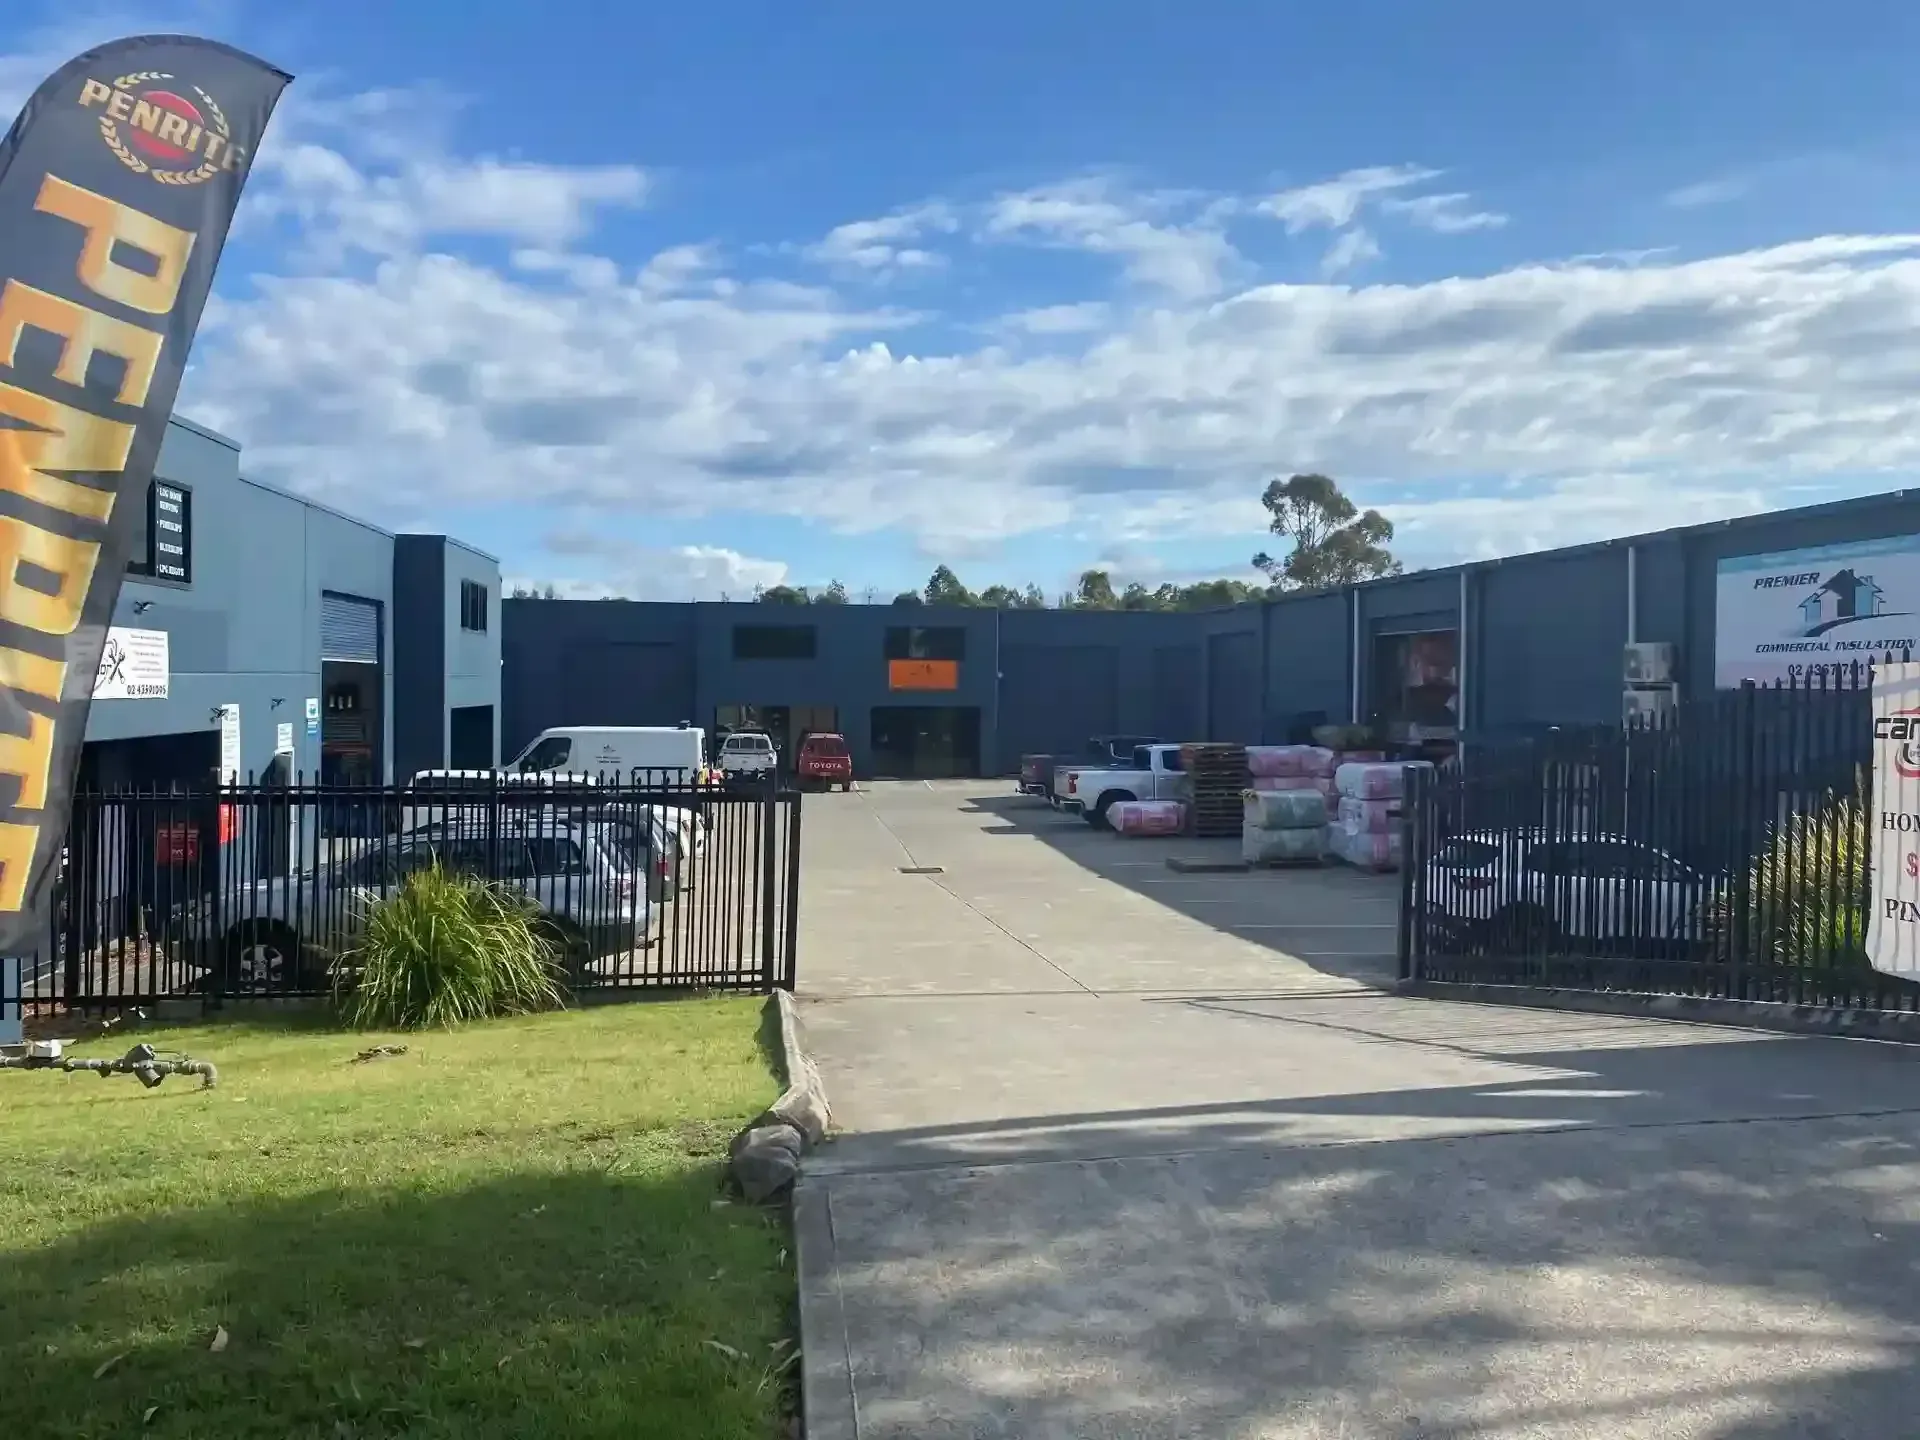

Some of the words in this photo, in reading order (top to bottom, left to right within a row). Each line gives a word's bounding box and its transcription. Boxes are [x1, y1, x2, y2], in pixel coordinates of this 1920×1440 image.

[78, 77, 245, 171] PENRITE
[0, 172, 197, 913] PENR
[1753, 571, 1820, 590] PREMIER
[1755, 642, 1831, 654] COMMERCIAL
[1834, 638, 1917, 651] INSULATION
[1788, 663, 1804, 677] 02
[808, 762, 844, 770] TOYOTA
